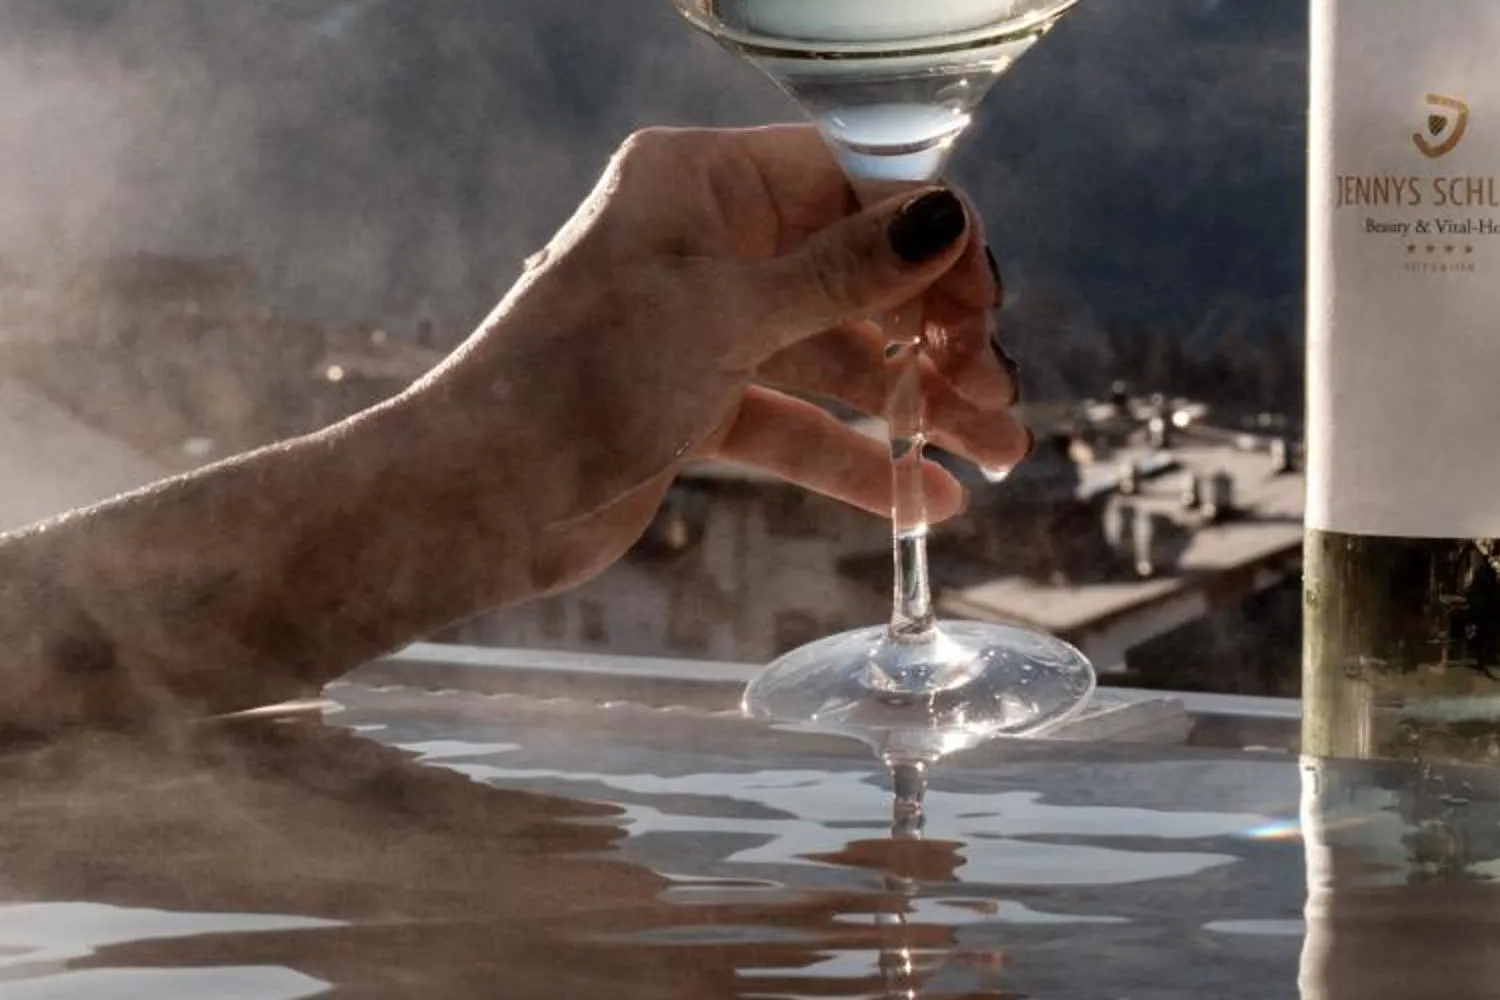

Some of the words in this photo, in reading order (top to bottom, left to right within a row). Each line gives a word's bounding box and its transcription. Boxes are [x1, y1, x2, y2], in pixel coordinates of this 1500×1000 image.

[1337, 175, 1422, 208] JENNYS
[1364, 217, 1410, 237] Beauty
[1415, 217, 1432, 234] &
